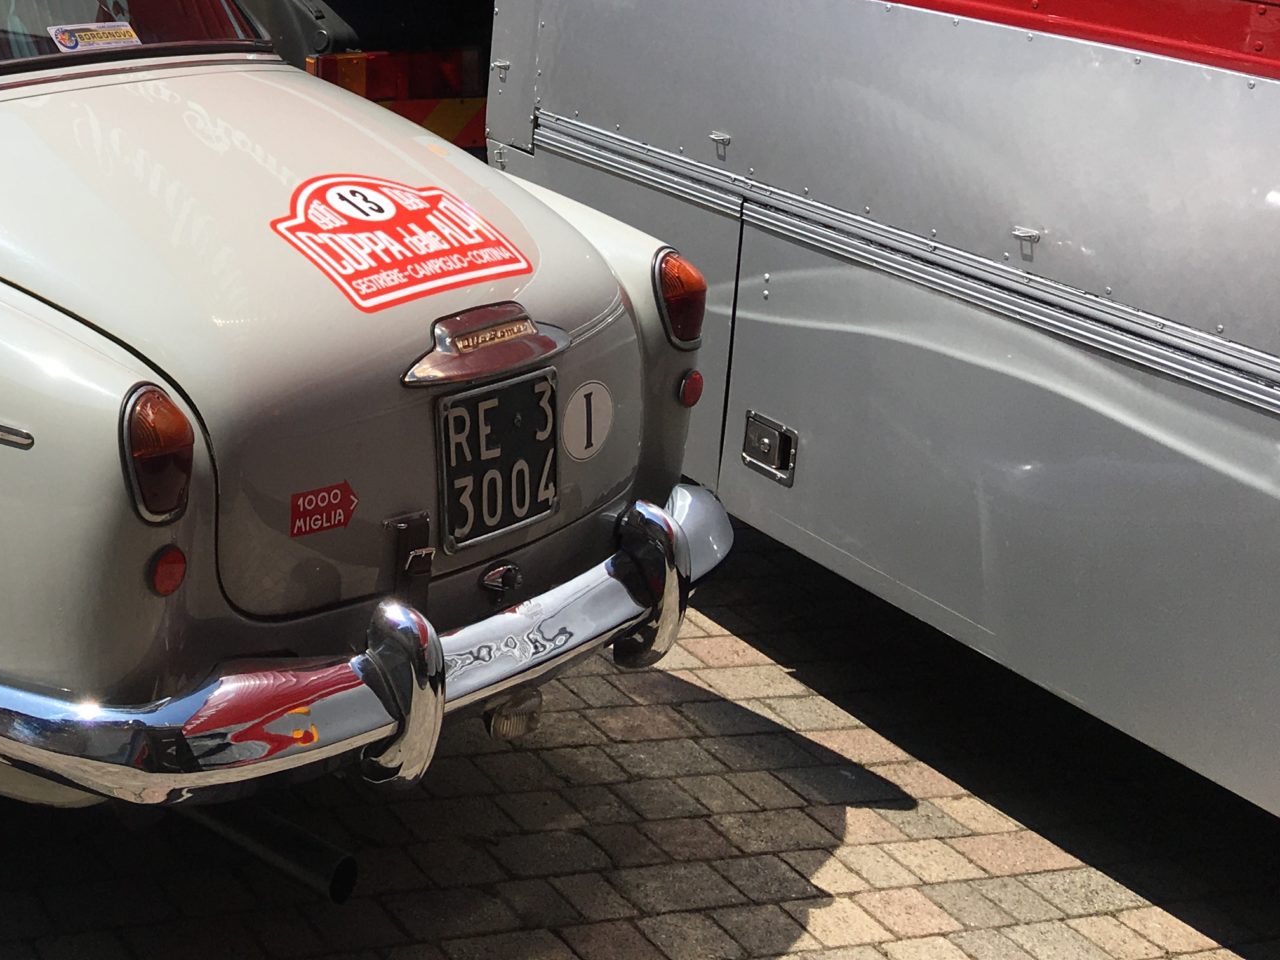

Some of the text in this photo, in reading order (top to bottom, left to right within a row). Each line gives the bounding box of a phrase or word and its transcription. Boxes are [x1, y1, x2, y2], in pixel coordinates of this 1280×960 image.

[336, 189, 385, 217] 13
[295, 197, 498, 276] COPPA delle ALPI
[447, 381, 553, 468] RE 3
[583, 391, 594, 450] I
[293, 509, 344, 535] MIGLIA
[297, 489, 341, 511] 1000
[453, 448, 555, 538] 3004
